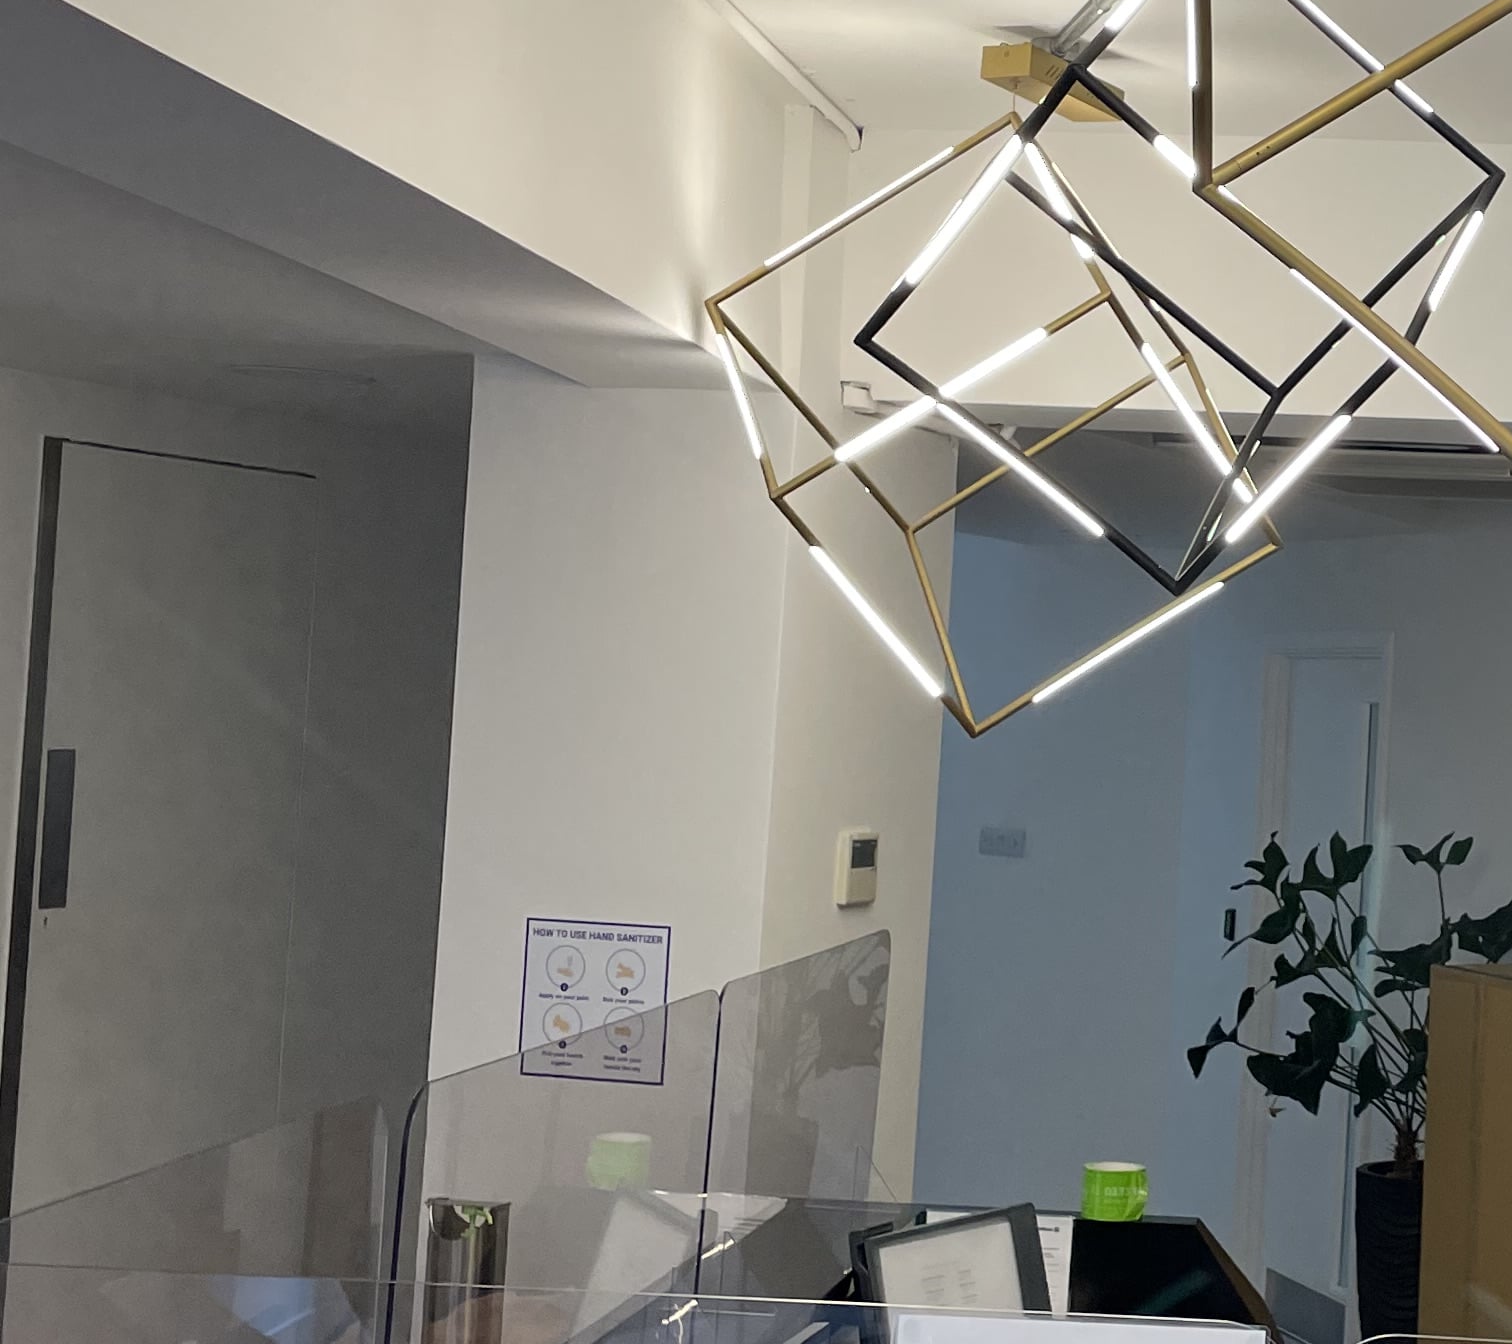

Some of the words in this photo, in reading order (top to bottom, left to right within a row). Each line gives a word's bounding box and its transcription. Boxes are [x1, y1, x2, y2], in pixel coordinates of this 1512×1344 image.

[533, 928, 554, 937] HOW
[557, 929, 568, 938] TO
[570, 930, 587, 940] USE
[588, 931, 614, 941] HAND
[617, 933, 663, 944] SANITIZER
